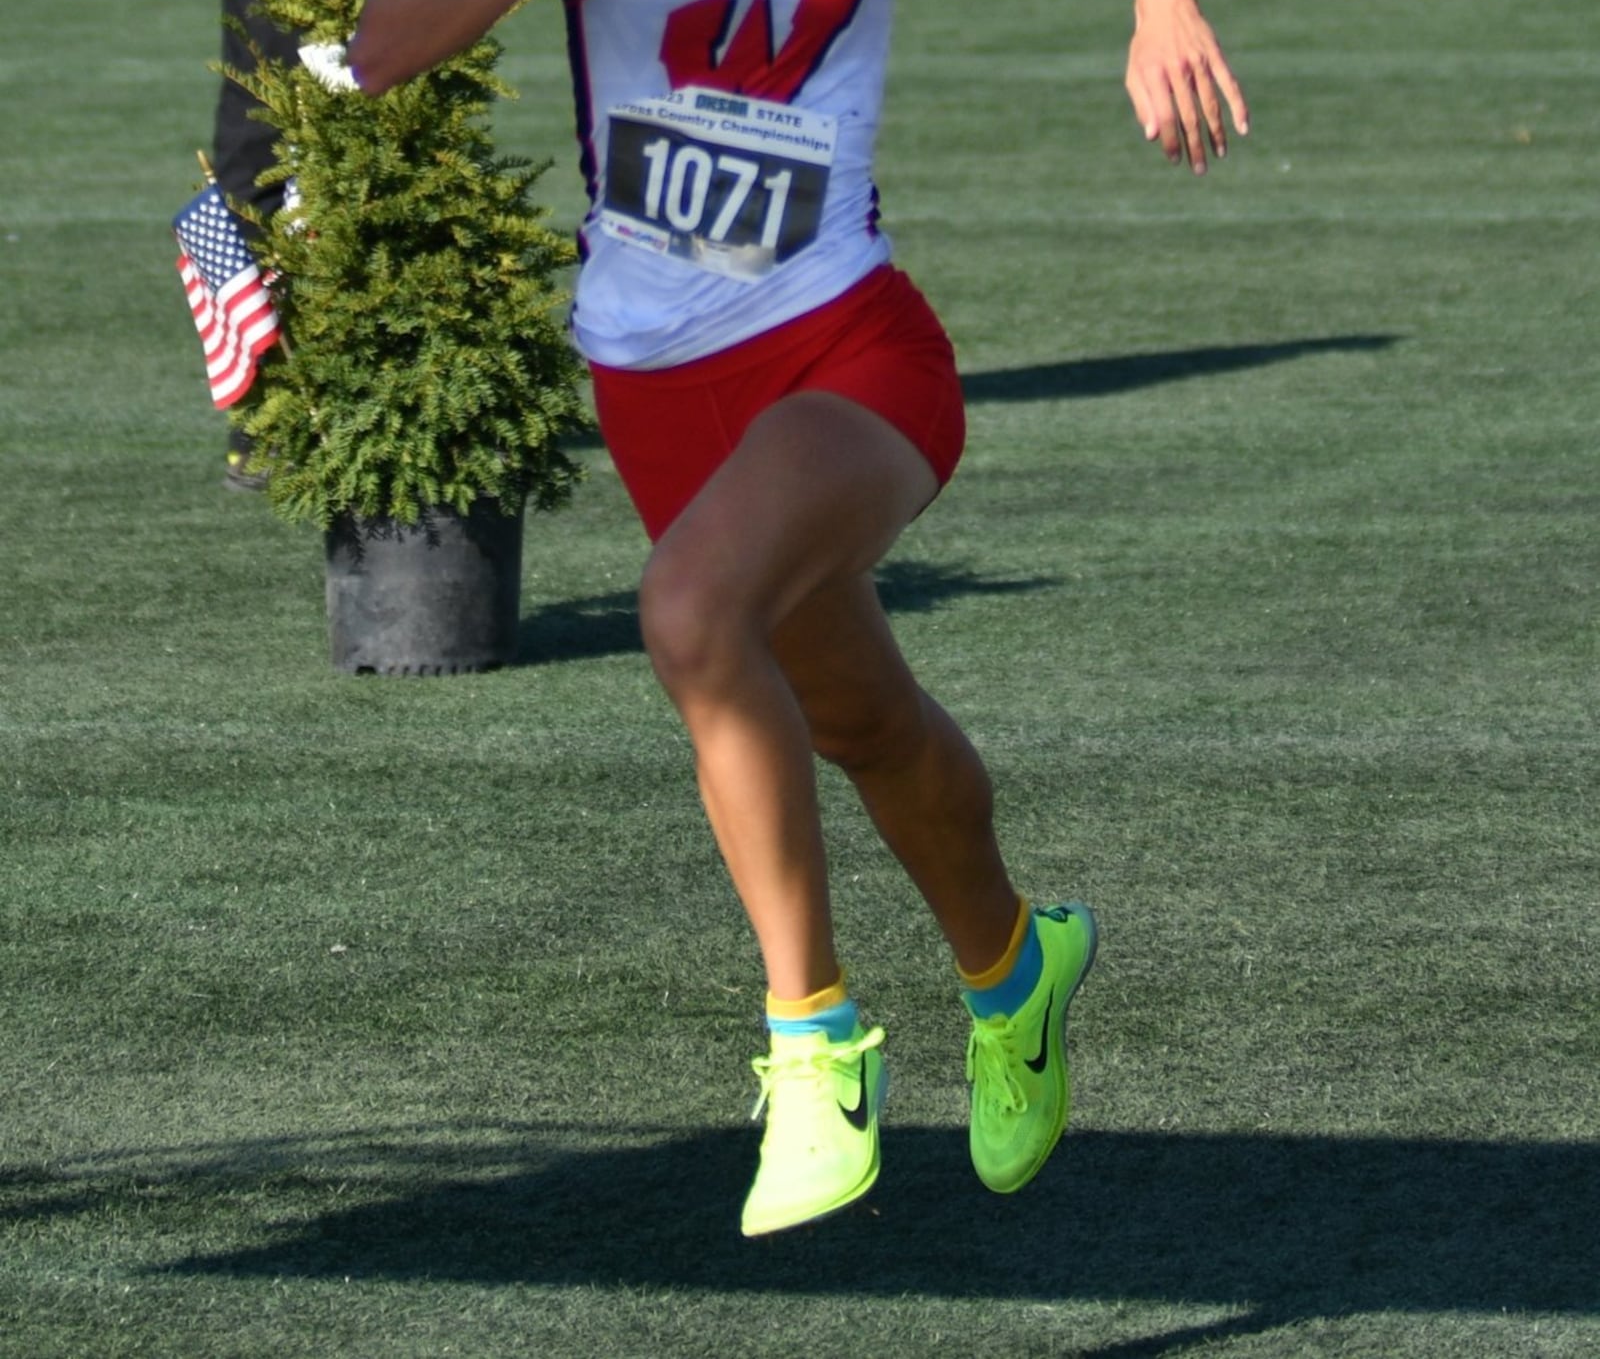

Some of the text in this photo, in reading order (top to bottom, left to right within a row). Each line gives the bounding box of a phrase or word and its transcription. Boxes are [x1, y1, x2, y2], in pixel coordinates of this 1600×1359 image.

[658, 107, 716, 131] Country
[721, 119, 832, 152] Championships
[756, 108, 803, 129] STATE
[642, 137, 793, 251] 1071
